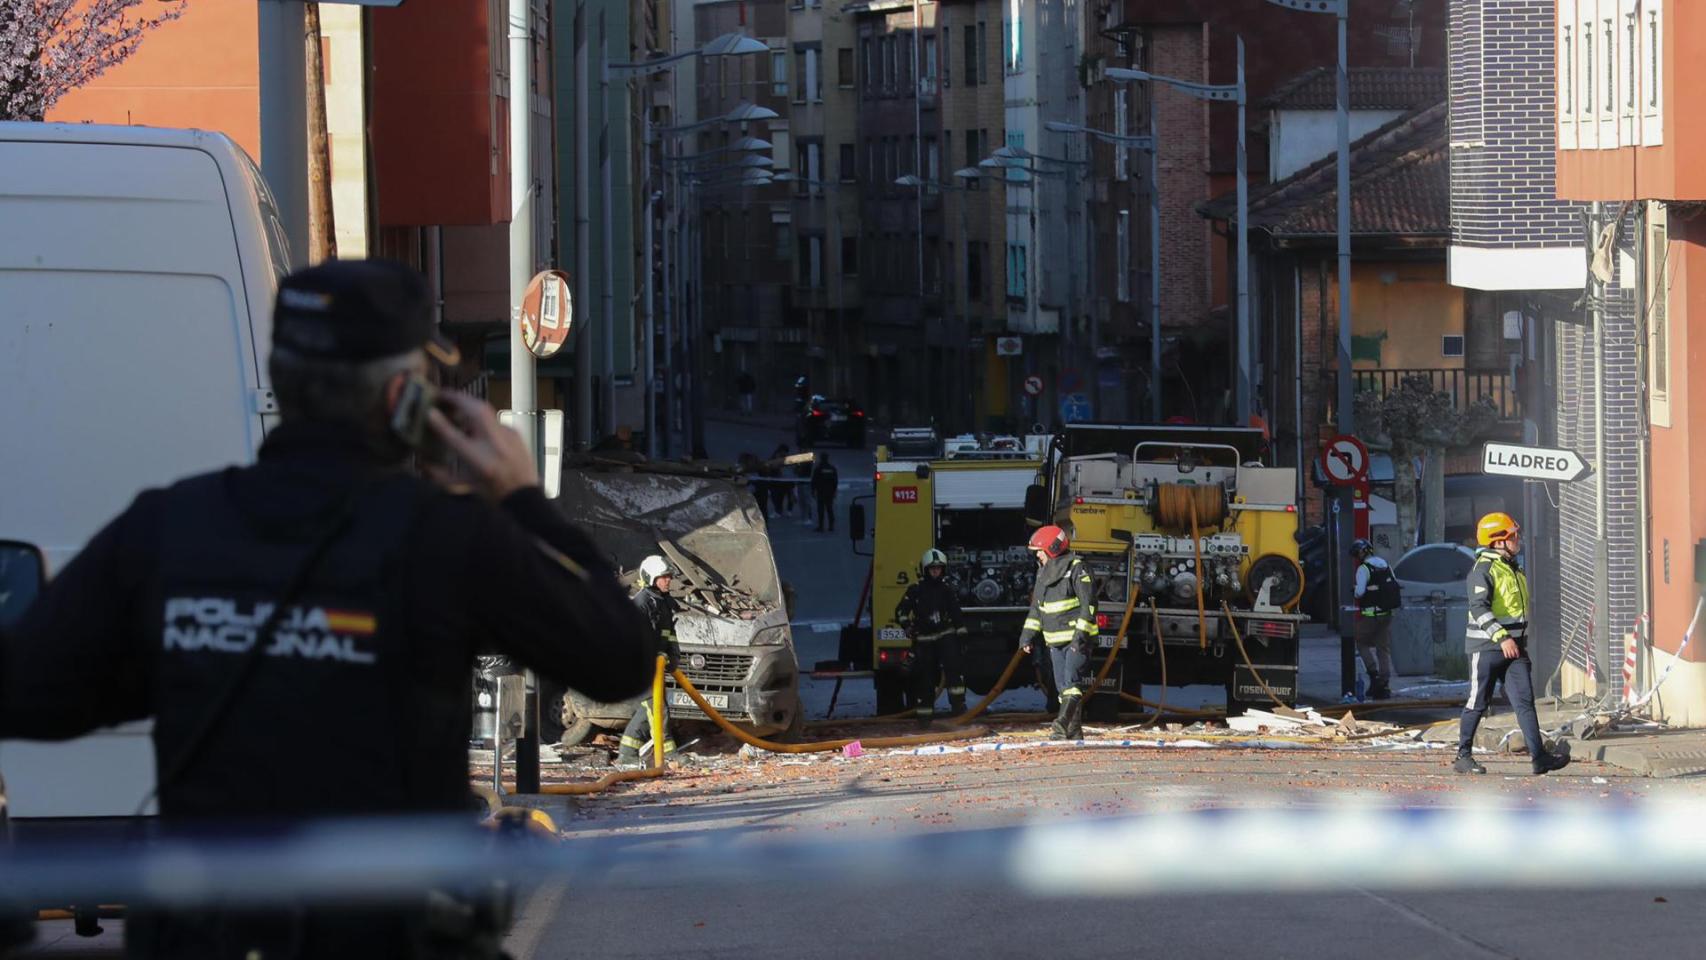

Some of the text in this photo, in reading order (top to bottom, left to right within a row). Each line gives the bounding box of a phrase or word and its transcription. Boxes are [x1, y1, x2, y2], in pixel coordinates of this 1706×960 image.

[1488, 452, 1568, 471] LLADREO
[901, 490, 916, 500] 112
[1239, 679, 1292, 696] rosenbauer
